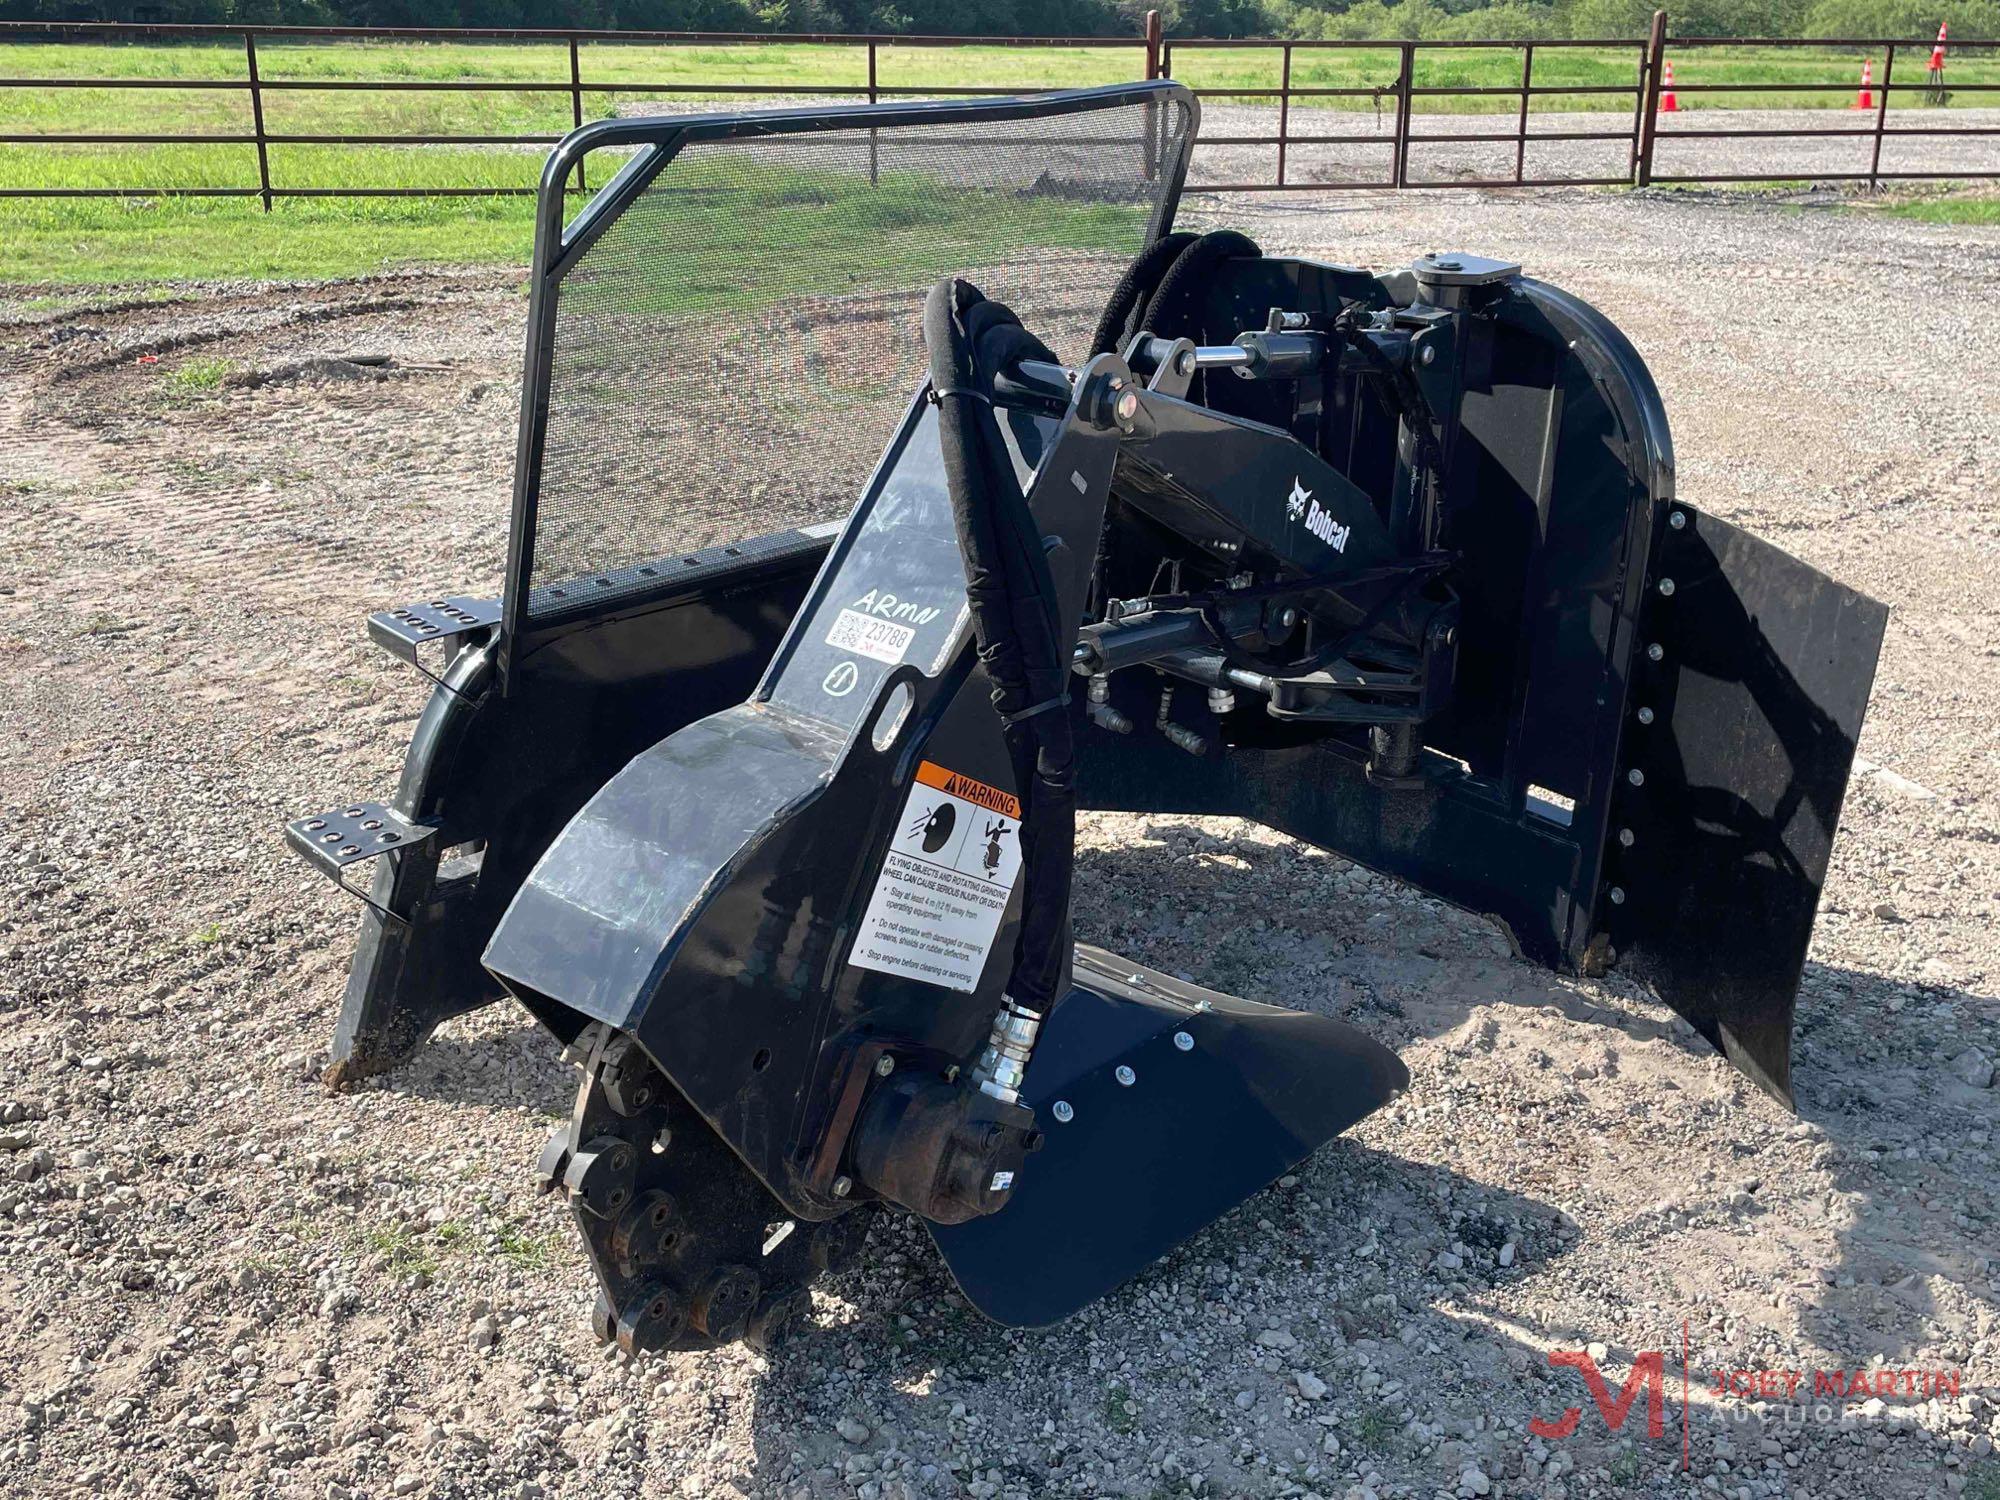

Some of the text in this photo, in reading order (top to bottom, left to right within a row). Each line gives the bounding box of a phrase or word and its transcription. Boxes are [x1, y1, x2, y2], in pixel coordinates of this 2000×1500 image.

[1305, 499, 1350, 554] Bobcat
[865, 622, 908, 648] 23788
[958, 777, 1016, 814] WARNING
[883, 867, 903, 880] WHEEL
[903, 873, 917, 884] CAN
[916, 877, 937, 890] CAUSE
[936, 883, 960, 898] SERIOUS
[960, 890, 980, 903] INJURY
[979, 896, 988, 905] OR
[889, 855, 1007, 900] FLYING OBJECTS AND ROTATING GRINDING
[890, 887, 904, 900] Stay
[886, 900, 914, 915] operating
[879, 918, 888, 928] Do
[888, 922, 899, 931] not
[898, 925, 920, 936] operate
[932, 934, 958, 946] damaged
[898, 937, 919, 948] shields
[925, 944, 944, 954] rubber
[867, 949, 882, 960] Stop
[881, 954, 901, 965] engine
[901, 958, 920, 969] before
[919, 963, 942, 976] cleaning
